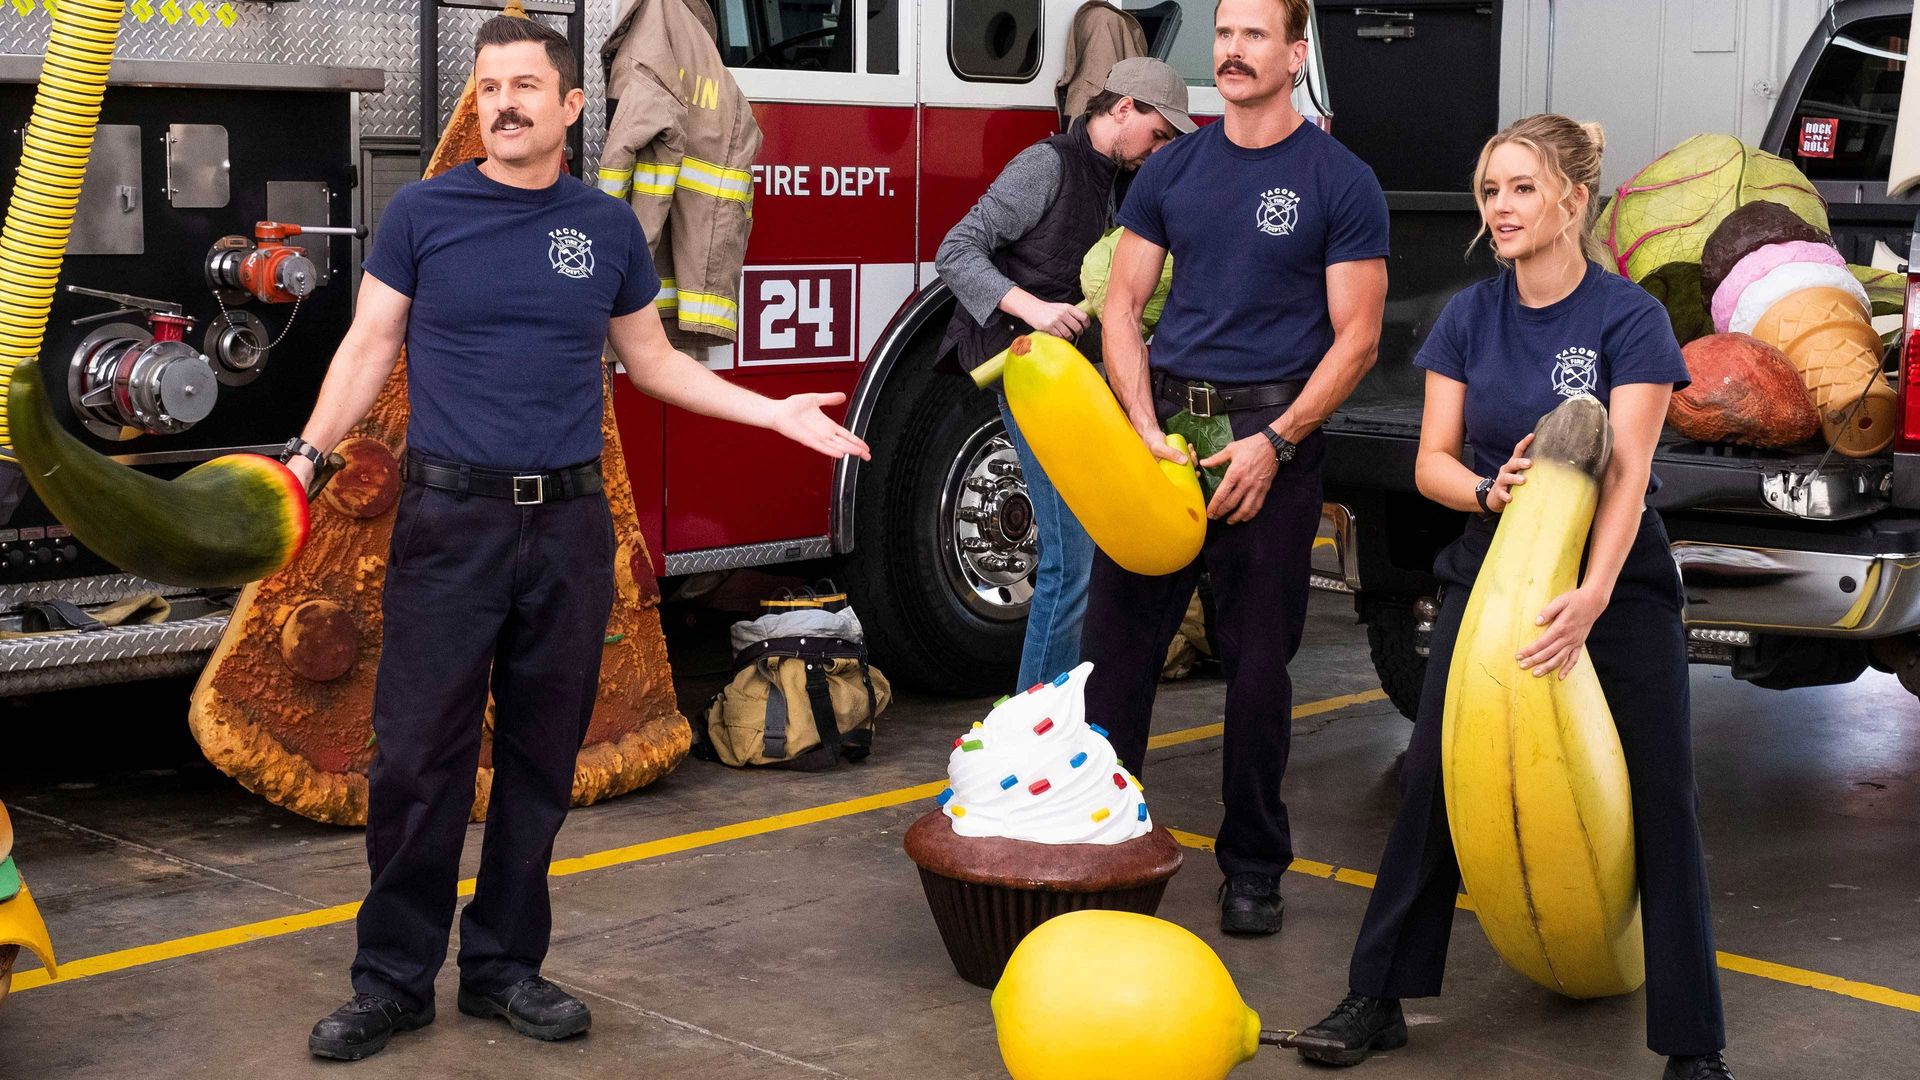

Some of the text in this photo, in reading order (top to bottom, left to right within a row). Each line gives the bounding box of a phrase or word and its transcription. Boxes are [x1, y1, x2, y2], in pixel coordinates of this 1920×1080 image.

[1805, 122, 1832, 135] ROCK
[1803, 140, 1829, 152] ROLL
[751, 164, 895, 197] FIRE DEPT.
[1260, 188, 1300, 203] TACOMA
[548, 227, 593, 247] TACOMA
[564, 239, 578, 247] FIRE
[760, 279, 834, 350] 24
